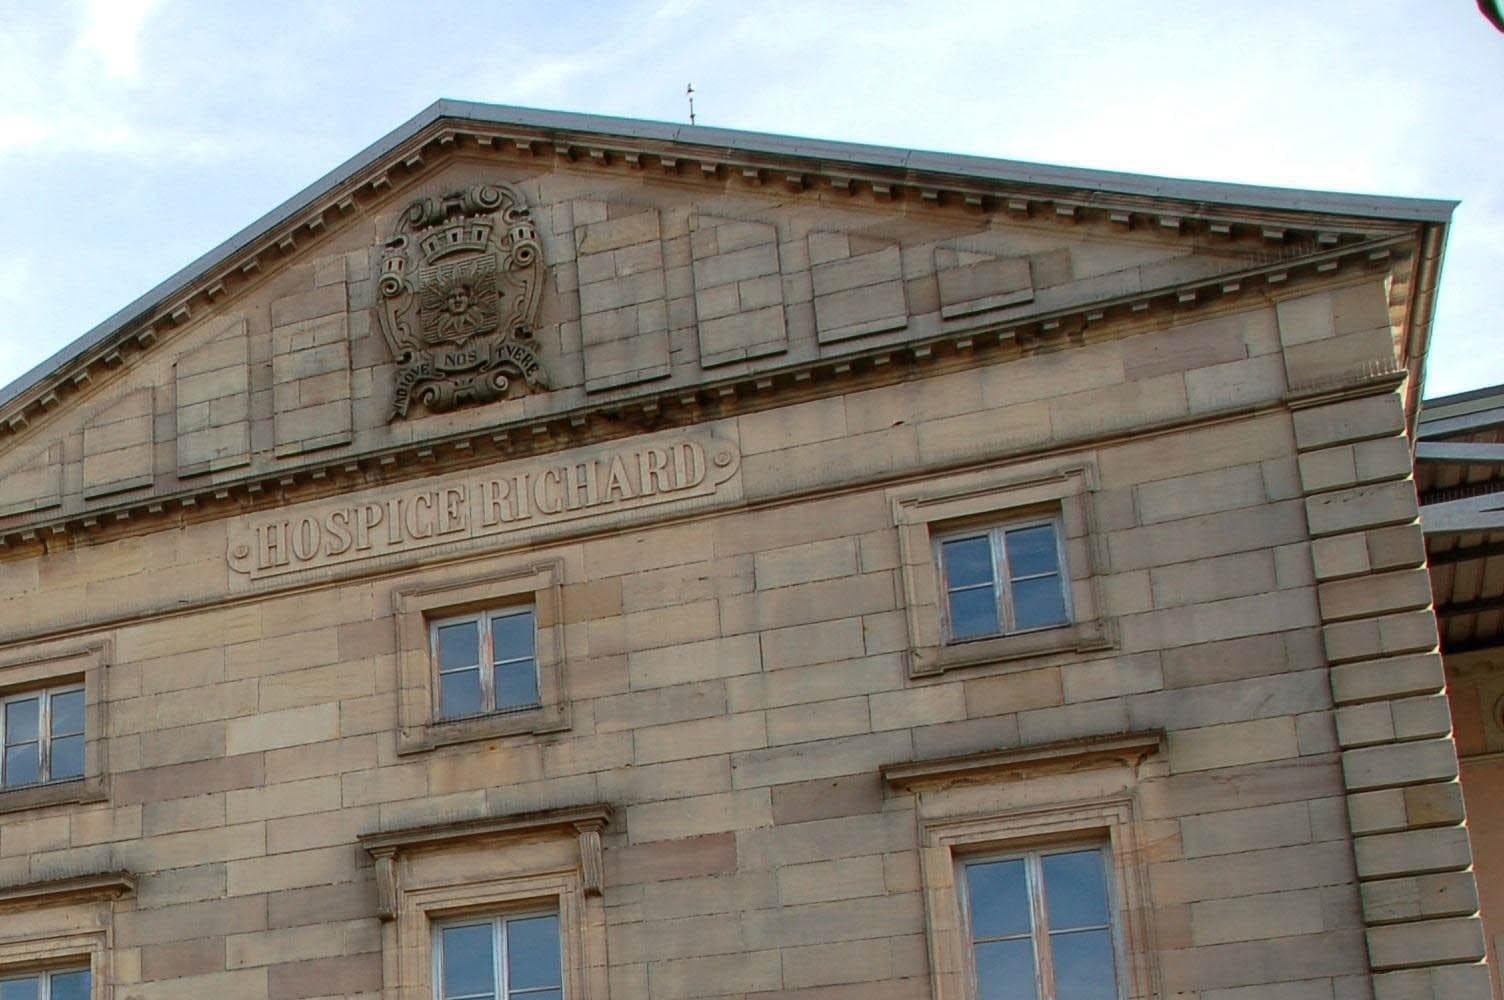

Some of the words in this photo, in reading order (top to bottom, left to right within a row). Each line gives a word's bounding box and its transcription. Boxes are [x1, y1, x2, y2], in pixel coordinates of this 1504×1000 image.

[445, 351, 477, 367] NOS
[256, 484, 467, 571] HOSPICE
[480, 440, 707, 528] RICHARD
